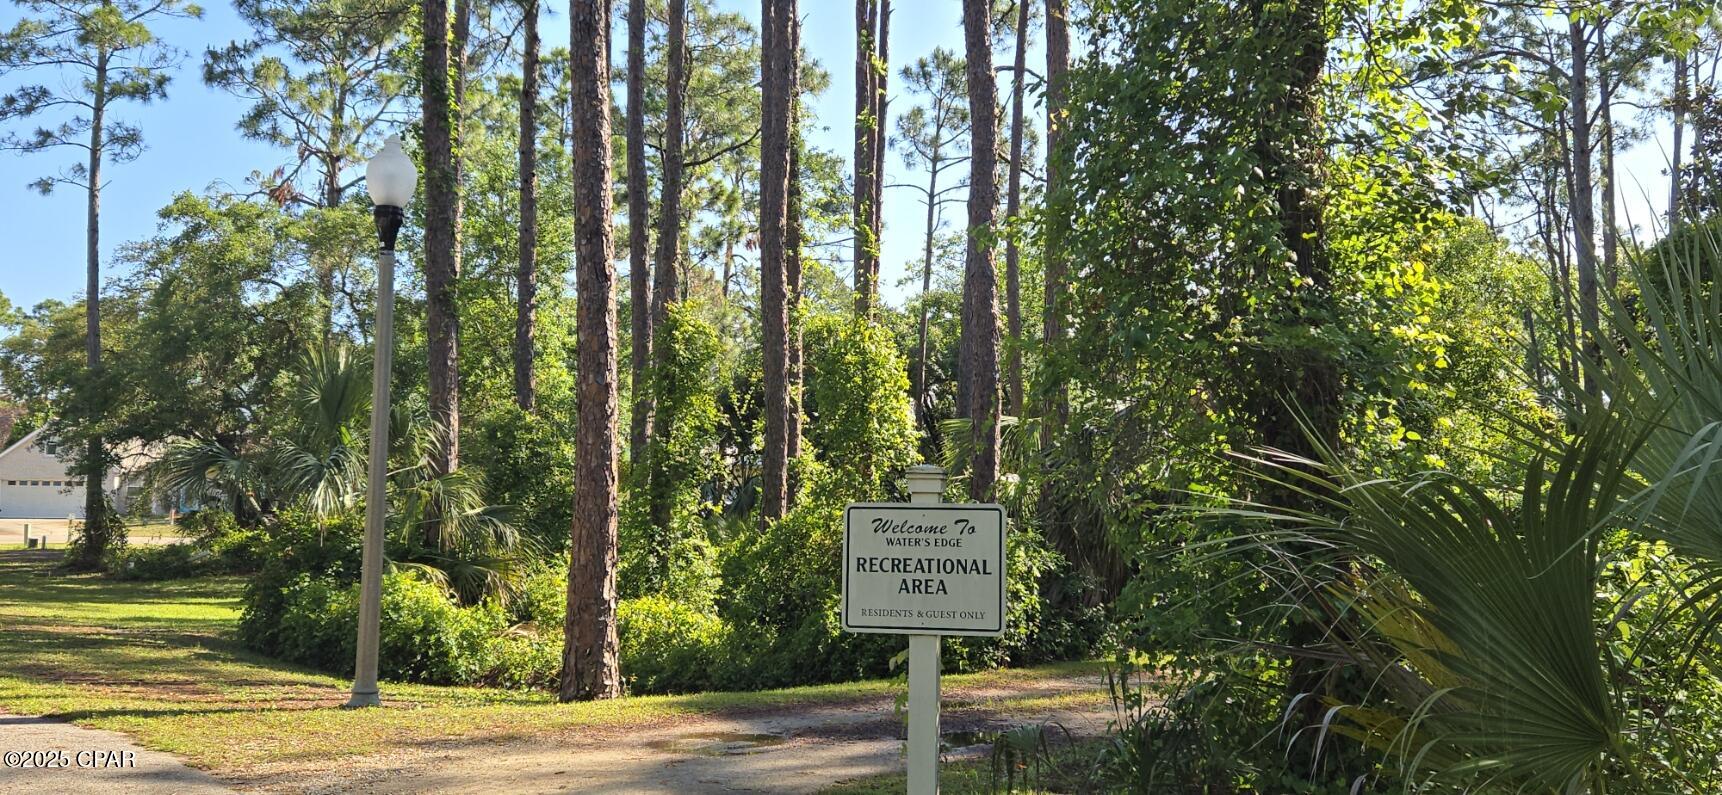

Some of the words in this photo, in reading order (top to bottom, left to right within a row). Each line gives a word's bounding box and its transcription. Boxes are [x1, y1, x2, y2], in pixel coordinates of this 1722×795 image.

[871, 517, 948, 534] Welcome
[954, 518, 977, 536] To
[886, 537, 931, 547] WATER'S
[934, 538, 963, 548] EDGE
[856, 557, 992, 575] RECREATIONAL
[898, 579, 948, 595] AREA
[861, 608, 913, 618] RESIDENTS
[917, 610, 926, 618] &
[926, 610, 957, 619] GUEST
[960, 611, 986, 620] ONLY
